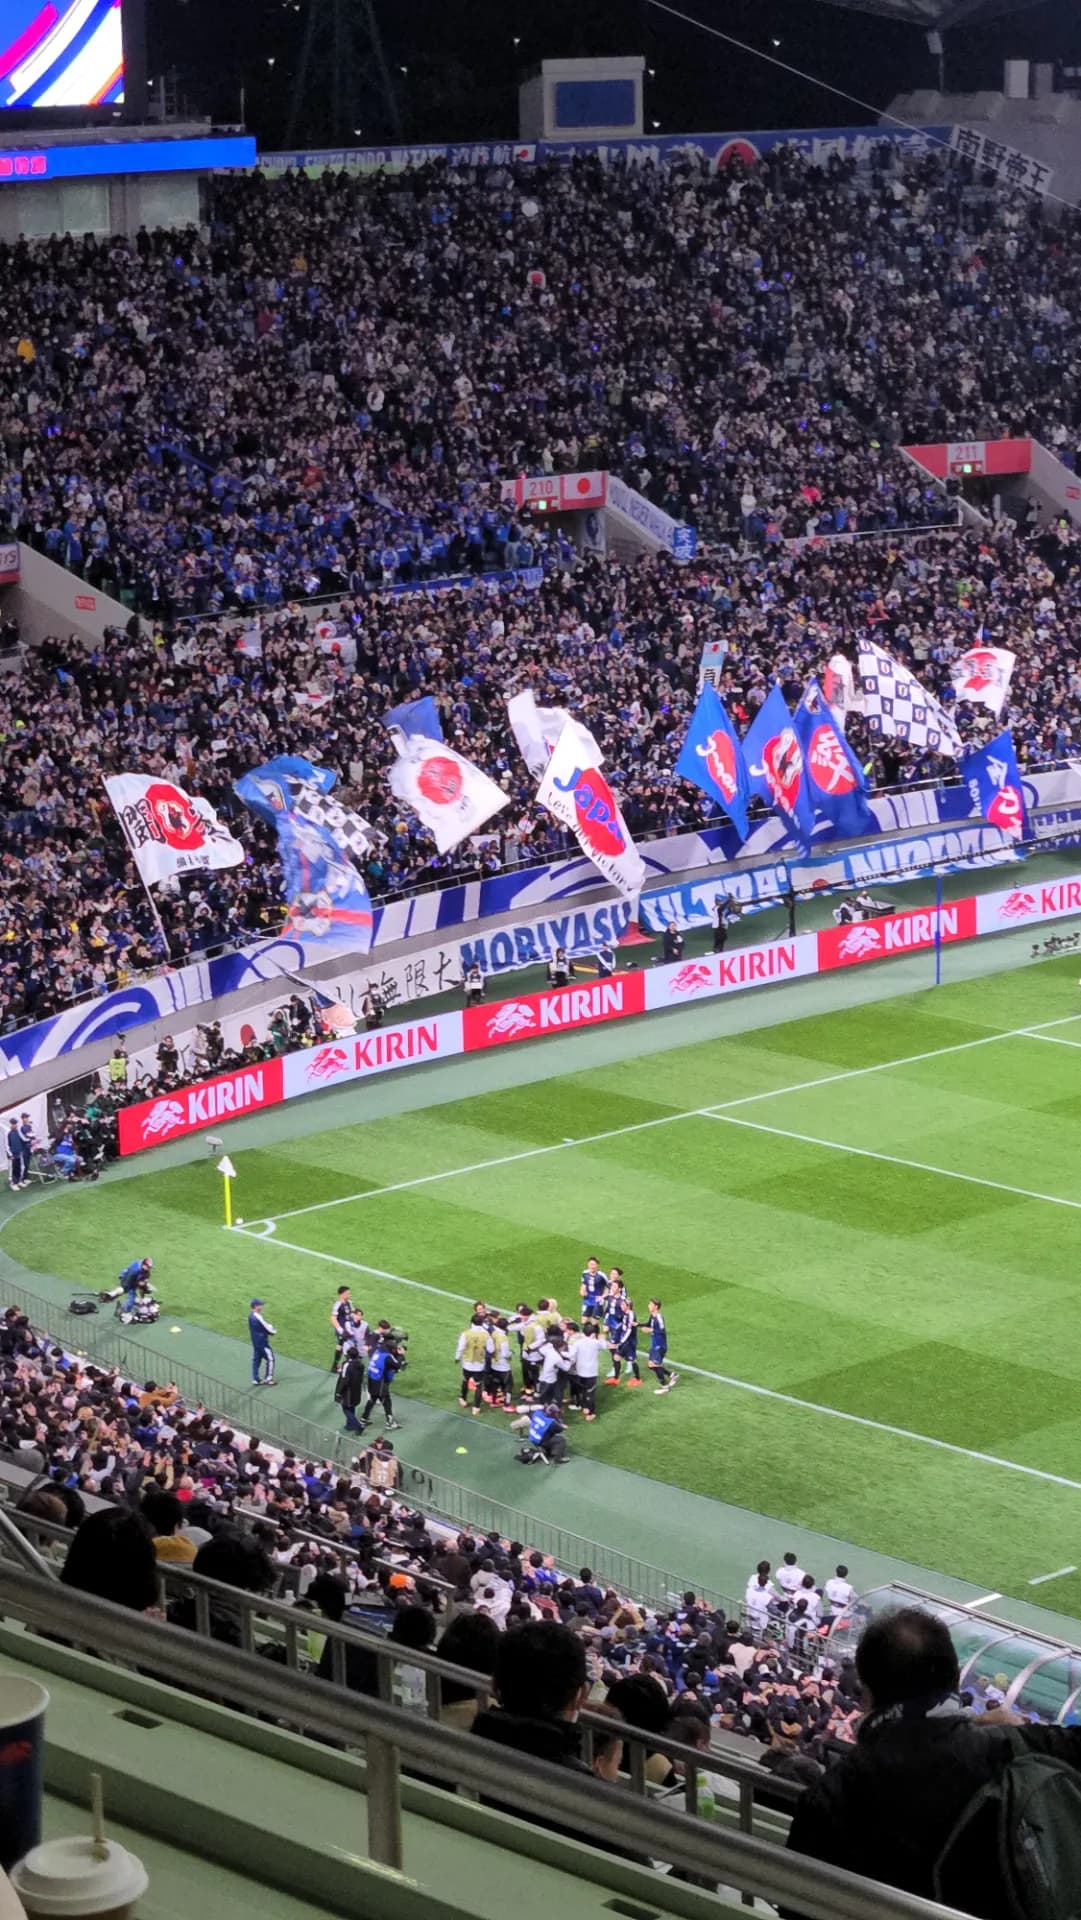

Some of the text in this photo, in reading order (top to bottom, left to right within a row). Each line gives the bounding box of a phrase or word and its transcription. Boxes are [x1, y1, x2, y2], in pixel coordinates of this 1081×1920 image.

[955, 445, 977, 460] 211
[530, 480, 553, 496] 210
[461, 901, 631, 975] MORIYASU
[885, 907, 958, 950] KIRIN
[719, 944, 795, 987] KIRIN
[540, 981, 623, 1028] KIRIN
[355, 1023, 438, 1070] KIRIN
[188, 1070, 264, 1124] KIRIN
